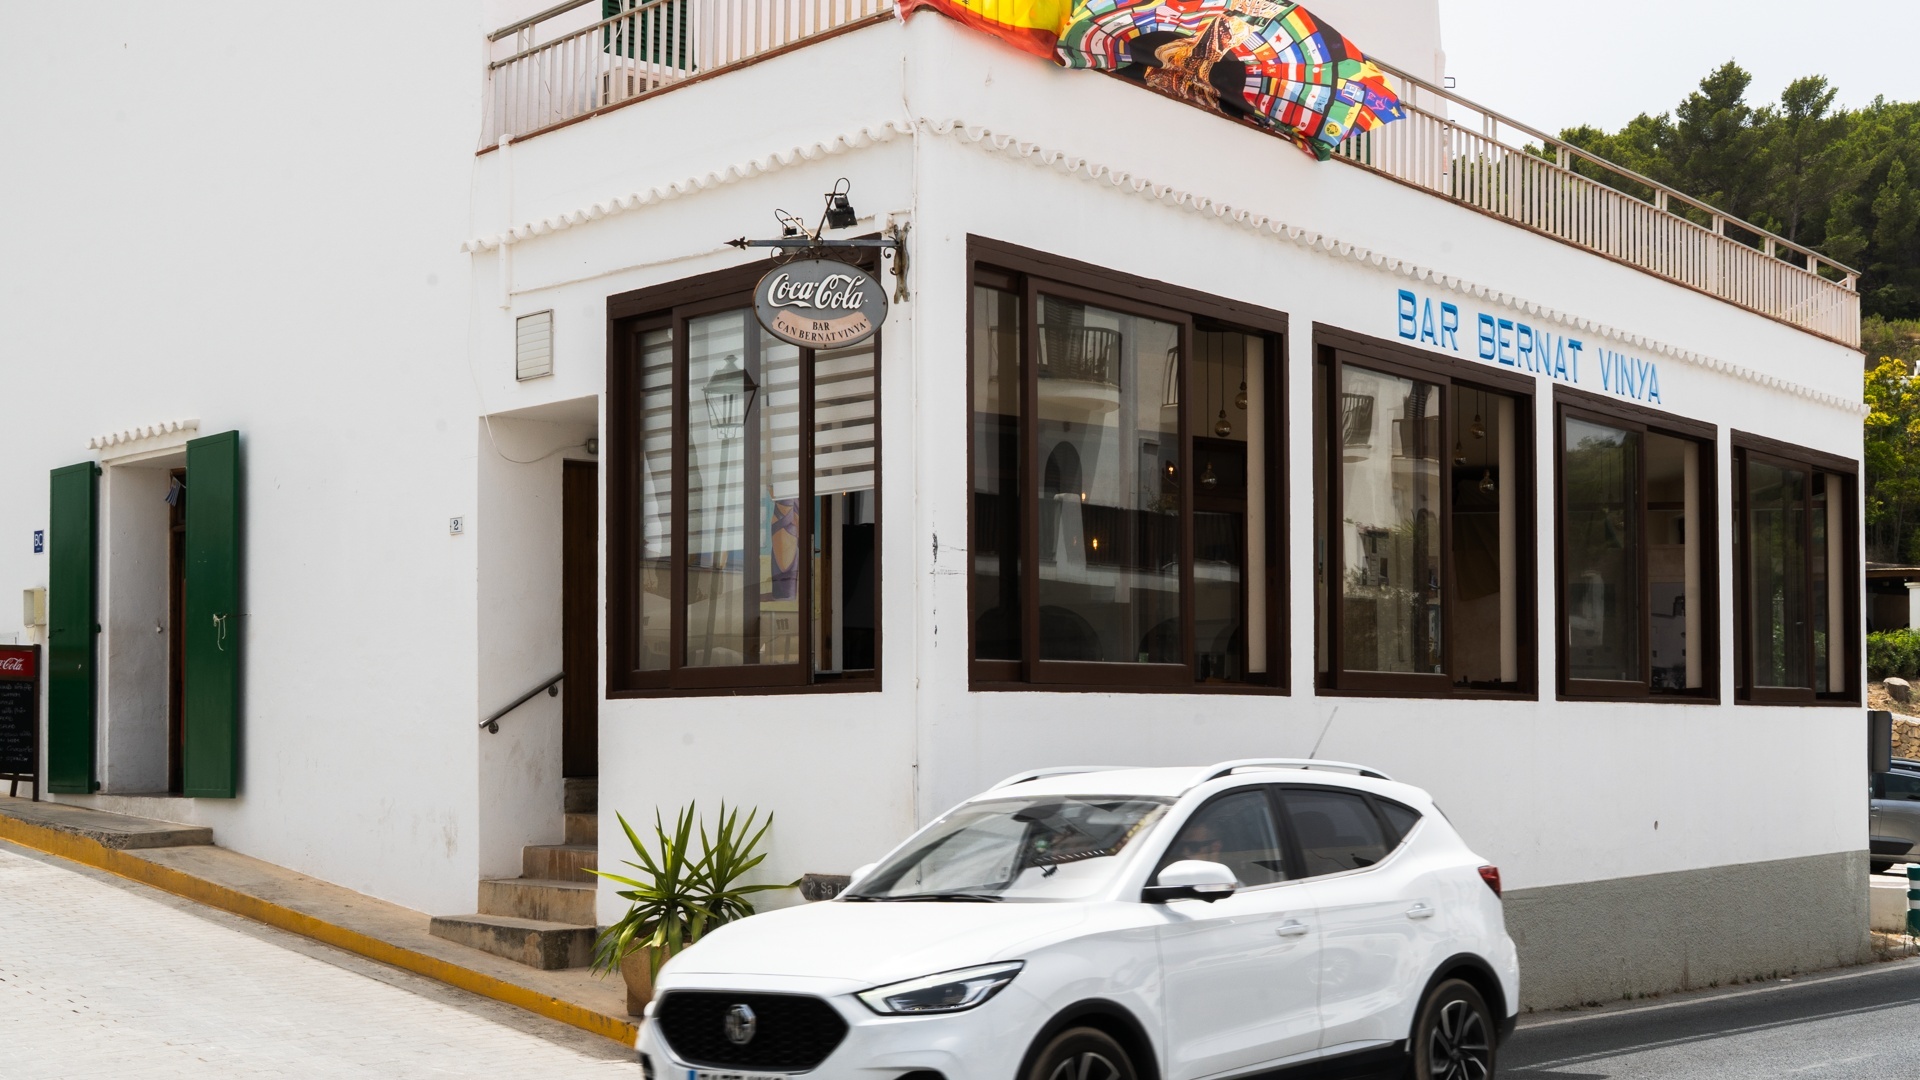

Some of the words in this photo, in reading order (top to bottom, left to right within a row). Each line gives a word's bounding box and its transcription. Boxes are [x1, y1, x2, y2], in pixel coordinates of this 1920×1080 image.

[767, 273, 866, 309] Coca-Cola
[777, 320, 796, 336] CAN
[799, 329, 836, 342] BERNAT
[837, 321, 867, 340] VINYA
[812, 321, 830, 331] BAR
[1398, 288, 1459, 352] BAR
[1477, 312, 1583, 384] BERNAT
[1598, 347, 1661, 405] VINYA
[453, 519, 459, 531] 2
[34, 533, 43, 547] BC
[820, 882, 833, 895] Sa
